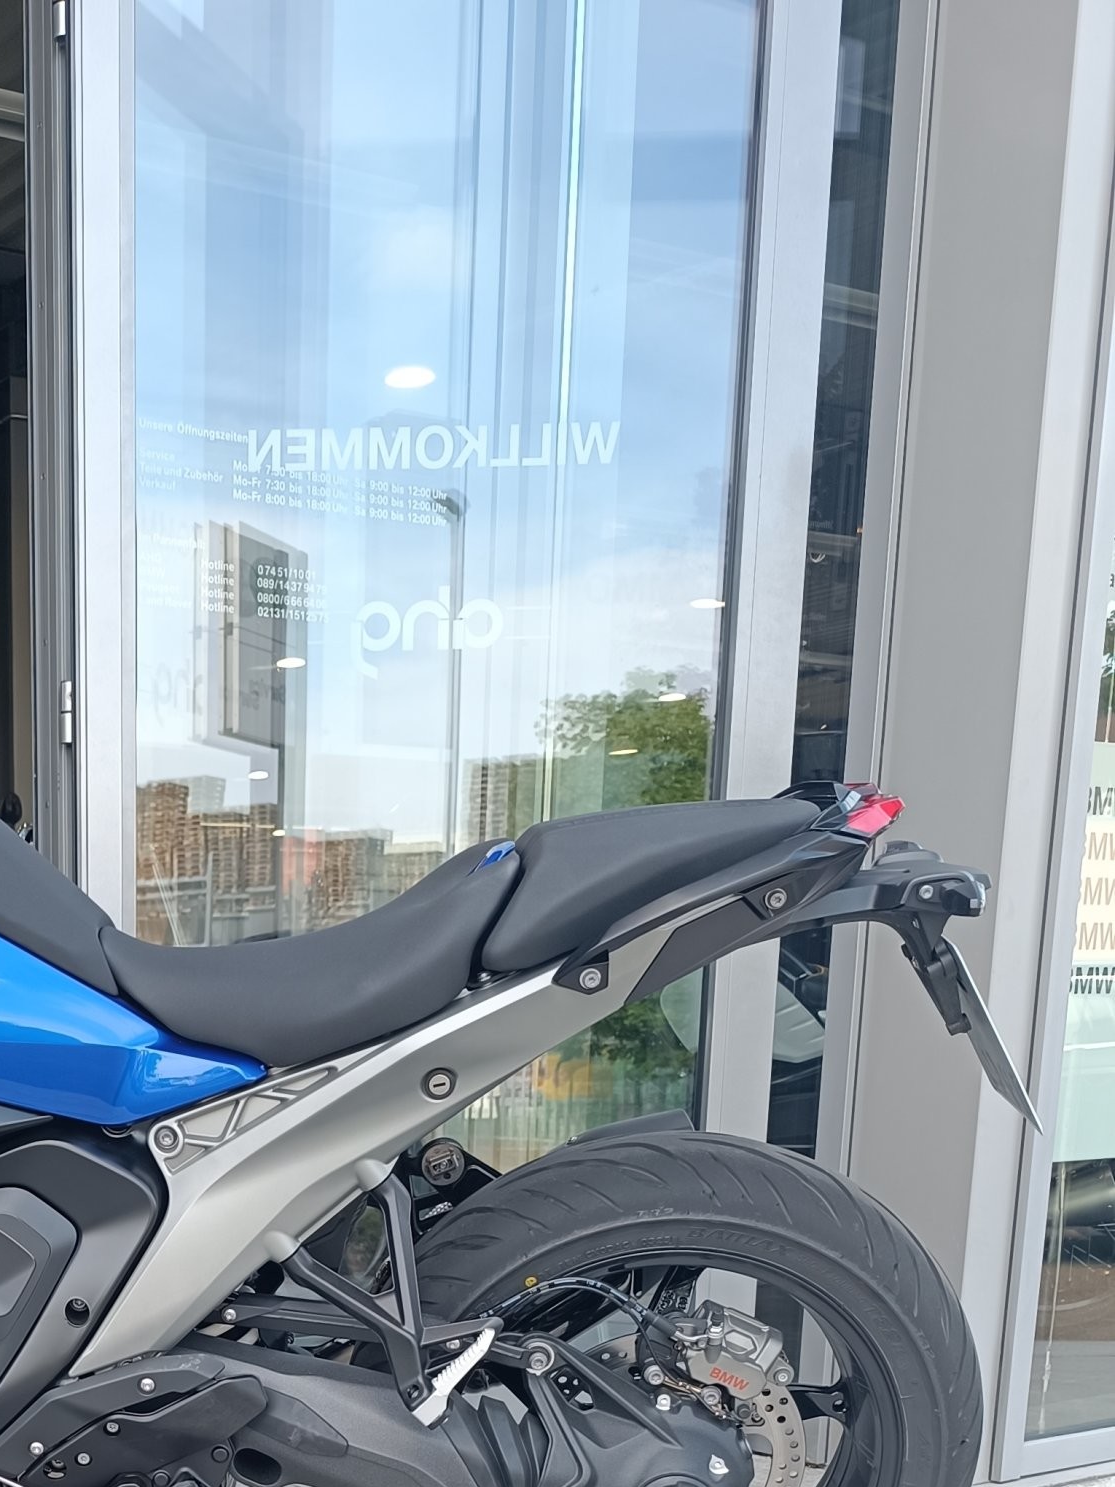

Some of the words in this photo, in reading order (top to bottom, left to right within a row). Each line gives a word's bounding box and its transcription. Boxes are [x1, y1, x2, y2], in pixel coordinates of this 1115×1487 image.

[139, 418, 173, 433] Unsere
[233, 474, 261, 488] Mo-Fr
[265, 479, 285, 492] 7:30
[289, 484, 303, 495] bis
[306, 486, 331, 498] 18:00
[370, 493, 389, 506] 9:00
[392, 497, 405, 509] bis
[408, 498, 431, 512] 12:00
[432, 501, 447, 514] Uhr
[370, 480, 389, 493] 9:00
[392, 484, 405, 496] bis
[408, 486, 431, 498] 12:00
[432, 488, 447, 500] Uhr
[232, 489, 261, 502] Mo-Fr
[265, 494, 285, 506] 8:00
[289, 498, 303, 509] bis
[306, 499, 331, 512] 18:00
[369, 507, 389, 520] 9:00
[391, 510, 404, 522] bis
[407, 512, 431, 525] 12:00
[200, 558, 235, 572] Hotline
[200, 572, 235, 586] Hotline
[200, 587, 235, 600] Hotline
[200, 600, 235, 614] Hotline
[709, 1367, 750, 1391] BMW
